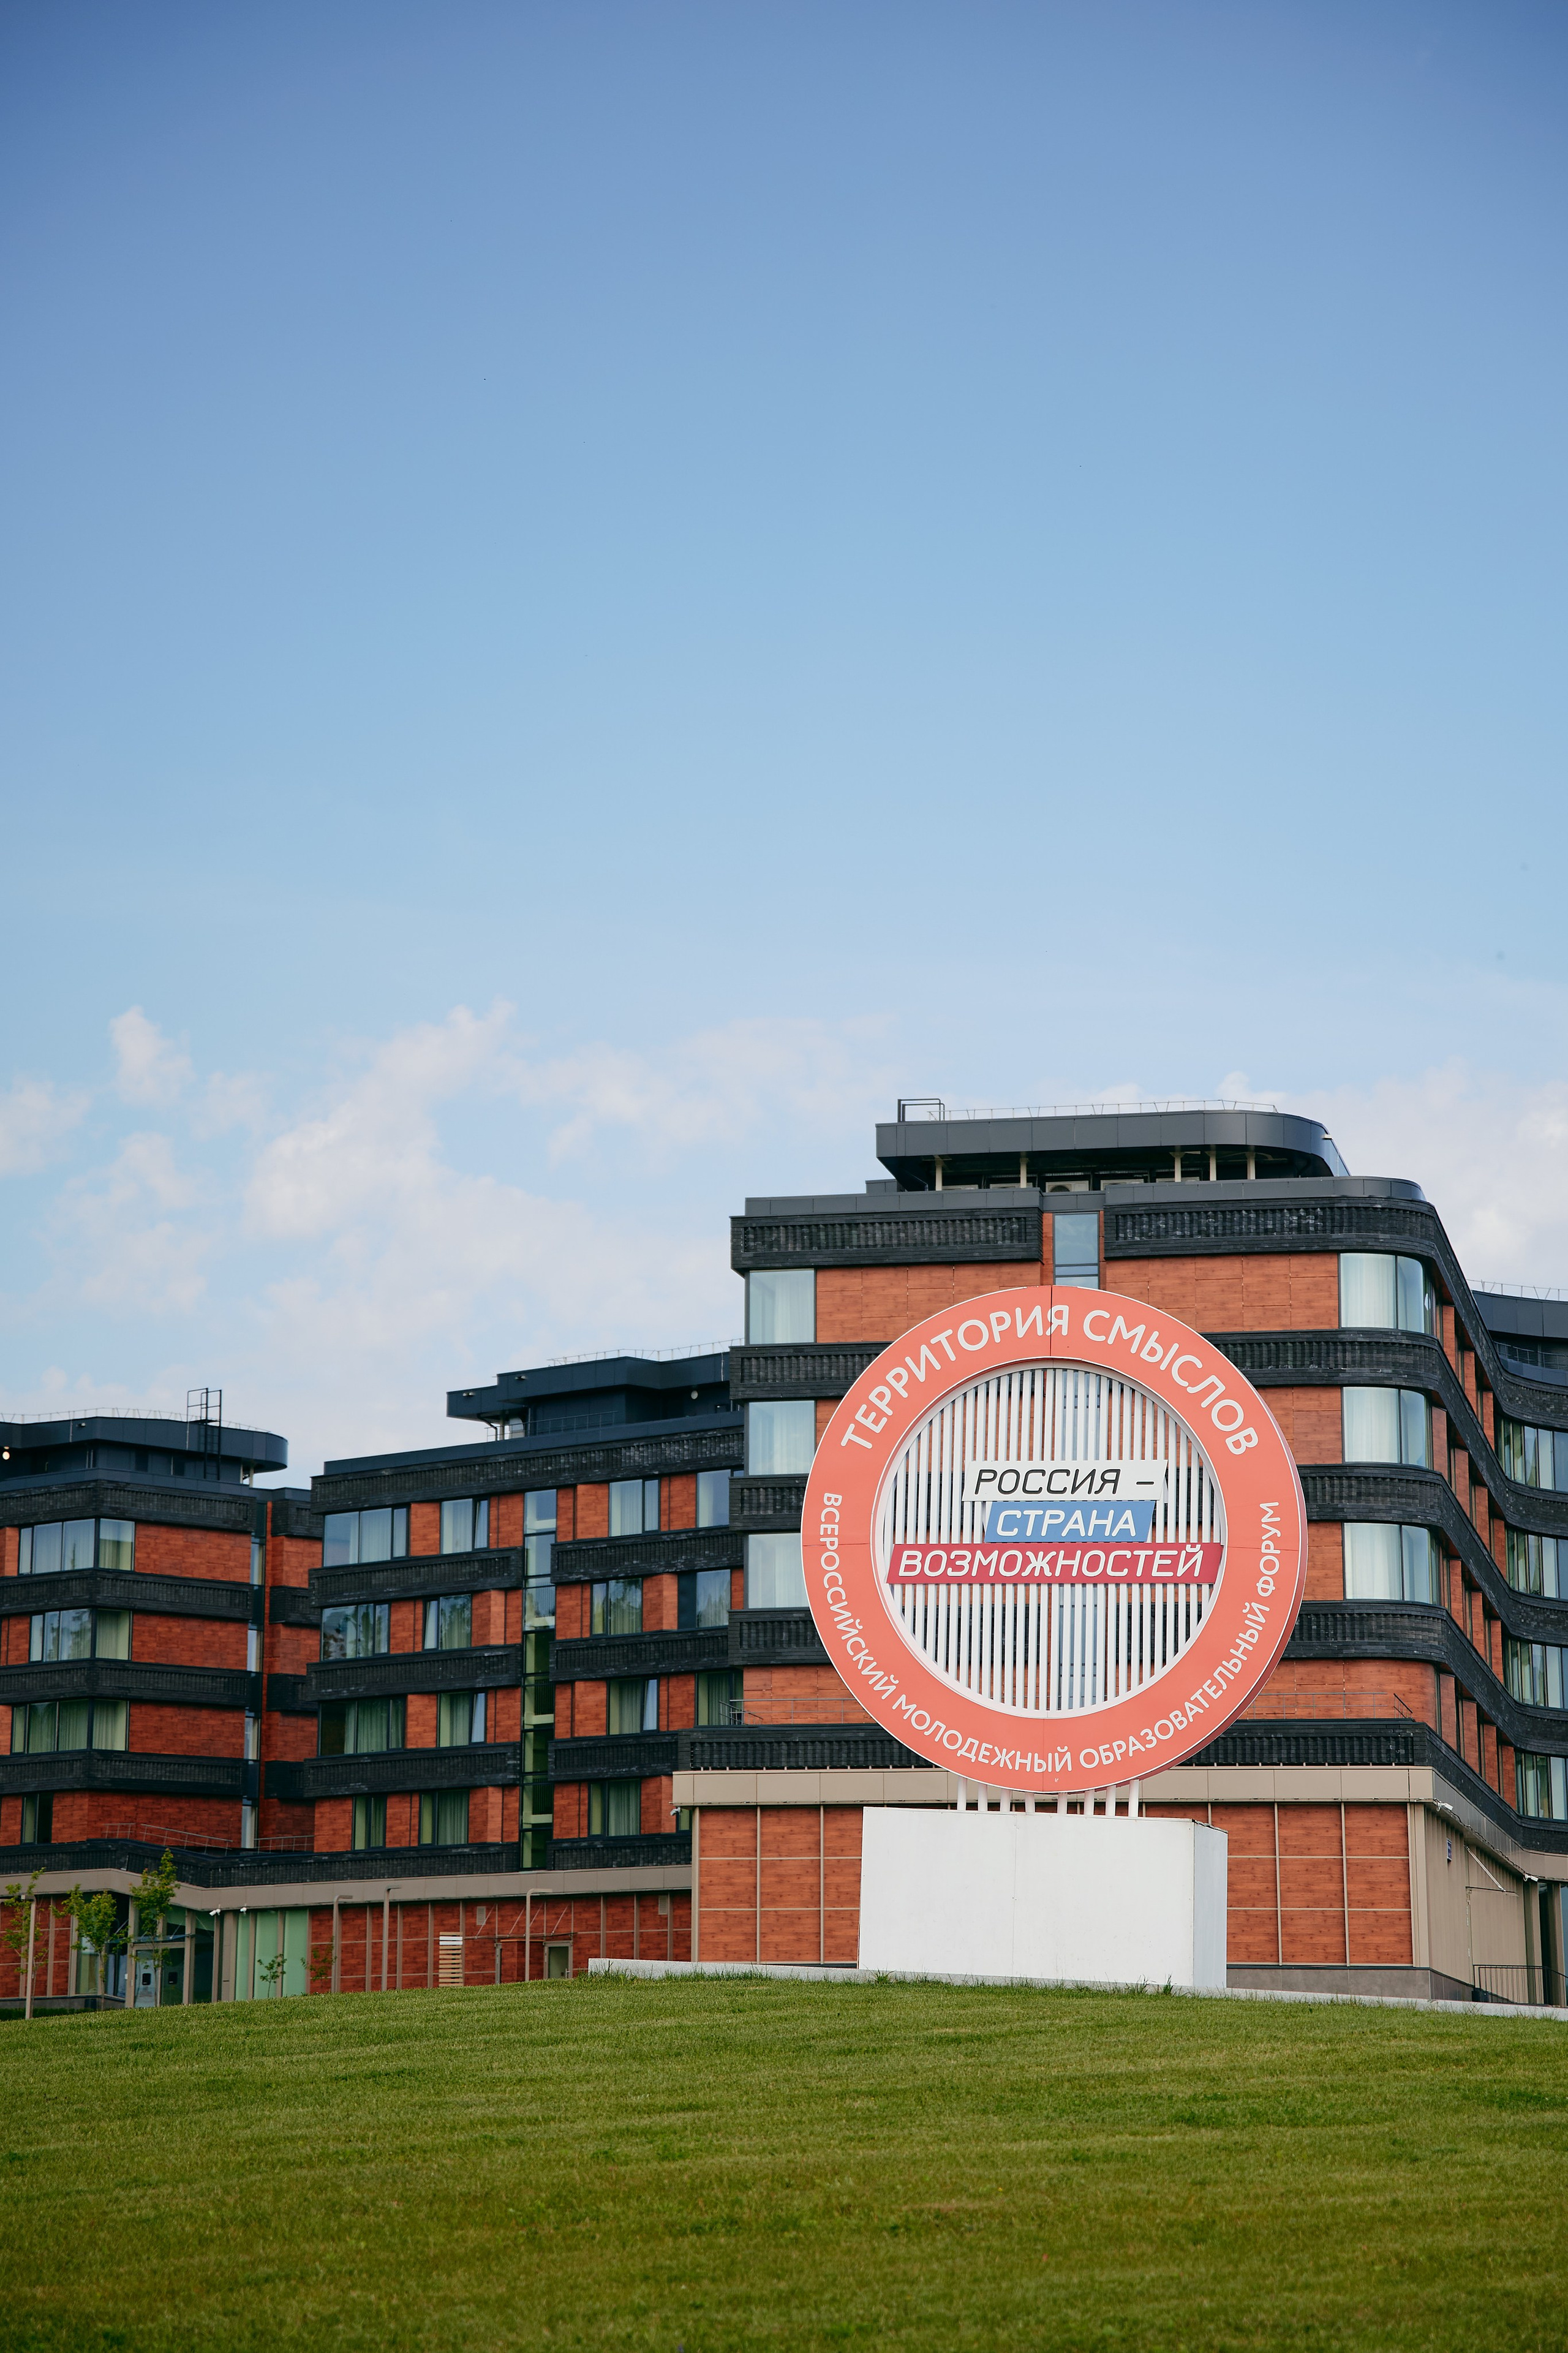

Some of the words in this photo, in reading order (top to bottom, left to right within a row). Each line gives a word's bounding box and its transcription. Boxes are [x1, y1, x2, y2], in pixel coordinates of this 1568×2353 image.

[840, 1305, 1069, 1449] ТЕРРИТОРИЯ
[1082, 1309, 1259, 1456] СМЫСЛОВ
[974, 1468, 1121, 1495] РОССИЯ
[997, 1509, 1137, 1537] СТРАНА
[898, 1544, 1204, 1577] ВОЗМОЖНОСТЕЙ
[820, 1492, 899, 1700] ВСЕРОССИЙСКИЙ
[892, 1694, 1072, 1773] МОЛОДЕЖНЫЙ
[1079, 1602, 1270, 1769] ОБРАЗОВАТЕЛЬНЫЙ
[1256, 1501, 1281, 1597] ФОРУМ
